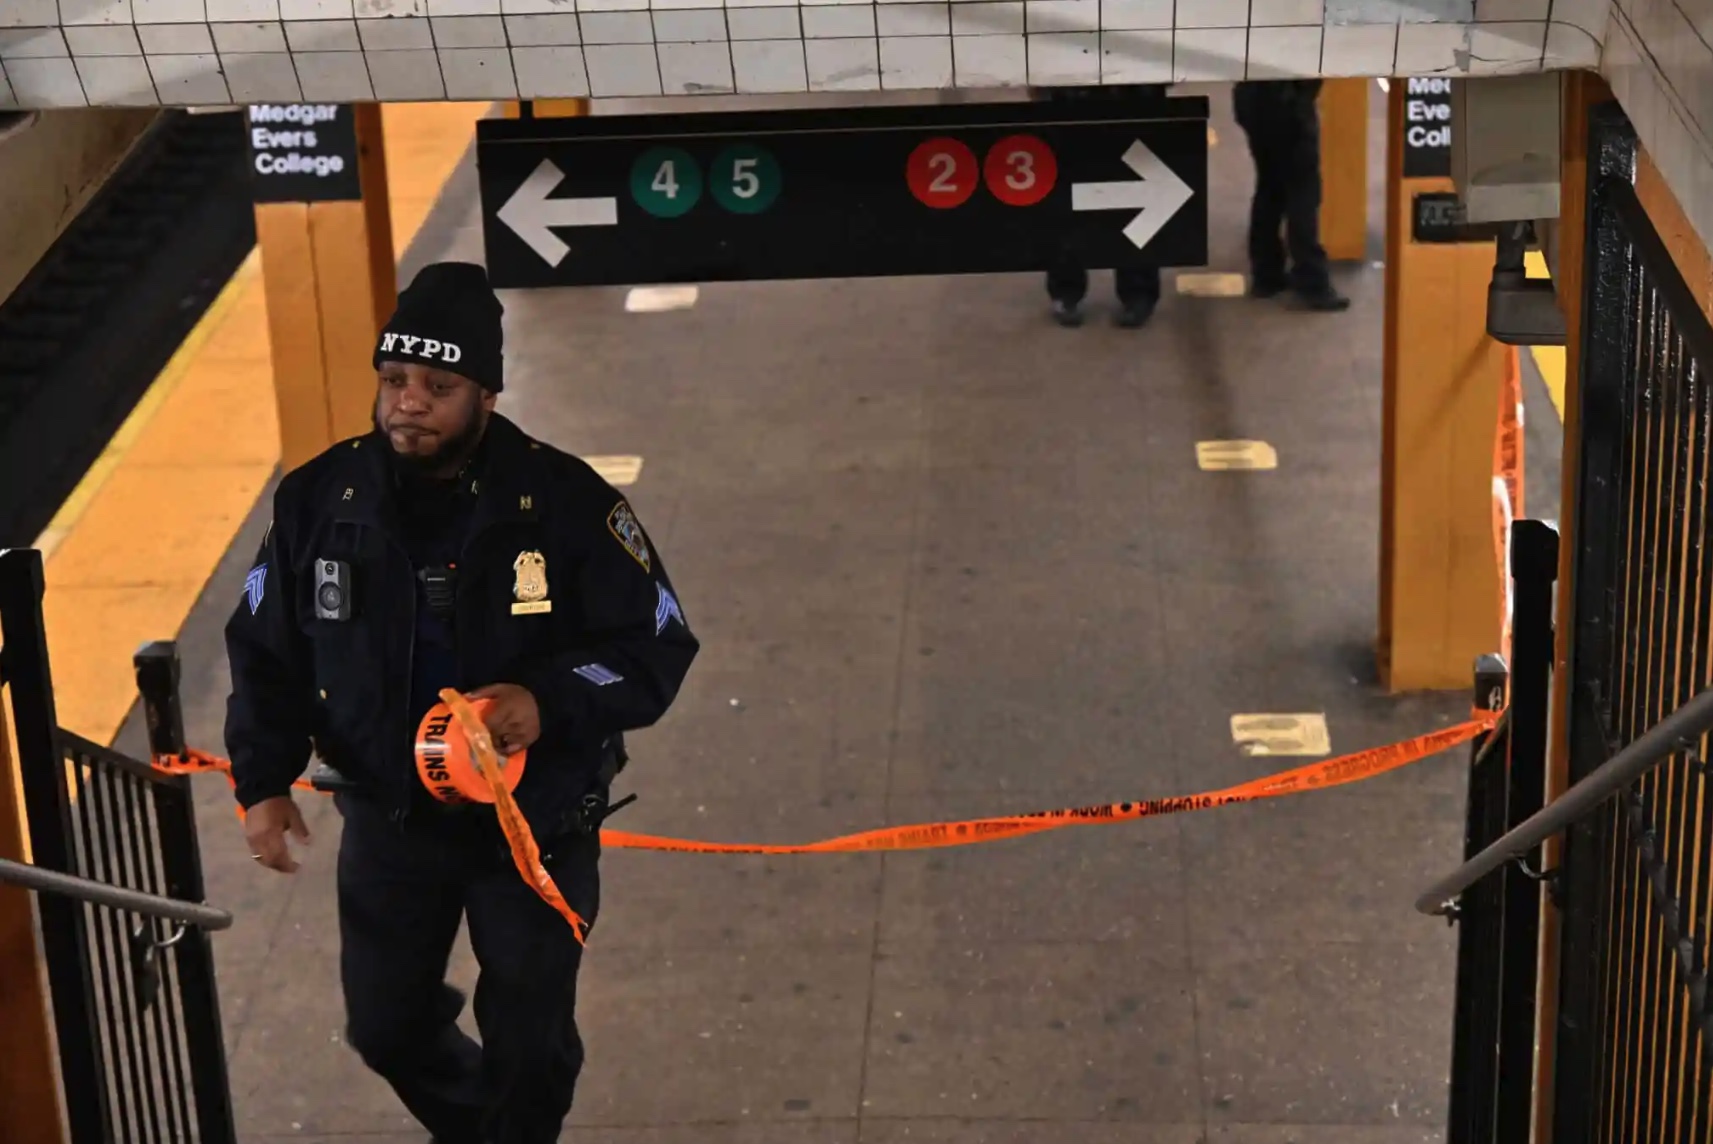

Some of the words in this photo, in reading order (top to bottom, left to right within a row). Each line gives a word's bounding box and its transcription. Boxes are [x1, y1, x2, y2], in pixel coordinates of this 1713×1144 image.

[250, 104, 338, 125] Medgar
[252, 127, 318, 149] Evers
[255, 152, 344, 177] College
[651, 160, 679, 199] 4
[732, 158, 759, 198] 5
[929, 153, 957, 192] 2
[1005, 151, 1035, 190] 3
[380, 333, 462, 363] NYPD
[424, 713, 453, 781] TRAINS
